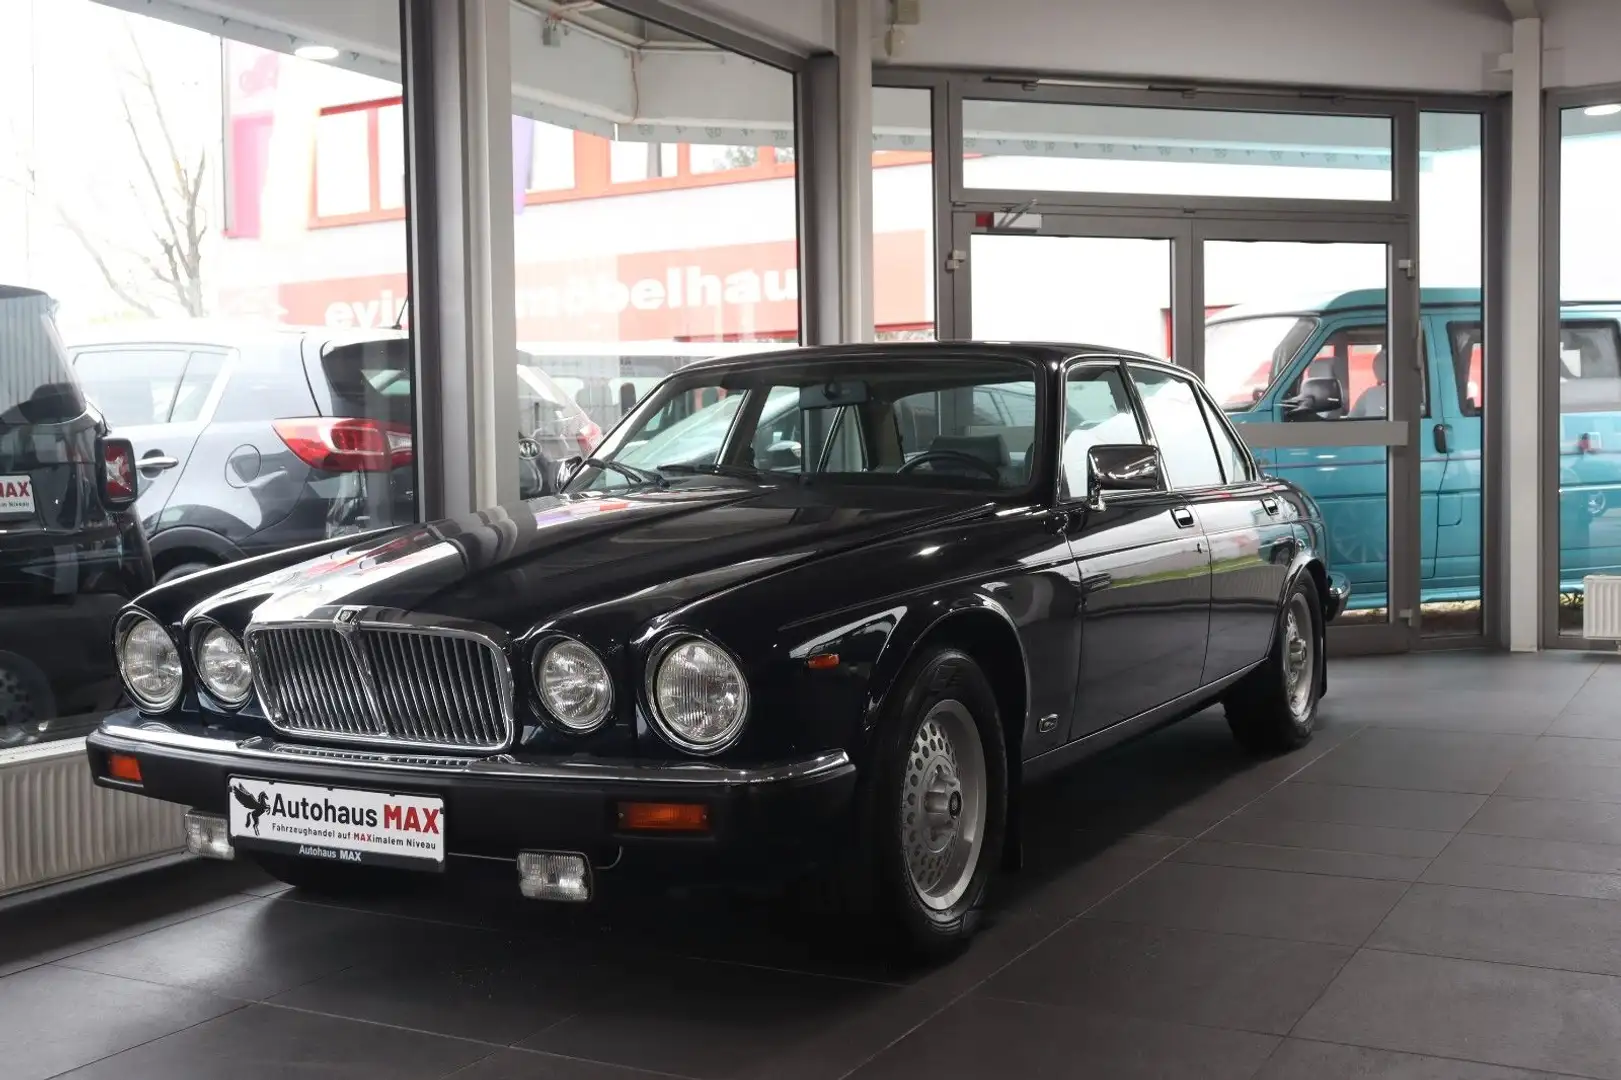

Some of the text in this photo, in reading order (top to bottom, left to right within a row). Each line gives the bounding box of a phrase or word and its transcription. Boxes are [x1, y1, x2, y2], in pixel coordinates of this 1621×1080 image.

[272, 793, 440, 835] Autohaus MAX
[272, 822, 436, 850] Fahrzeughandel auf MAXimalem Niveau
[299, 845, 362, 862] Autohaus MAX
